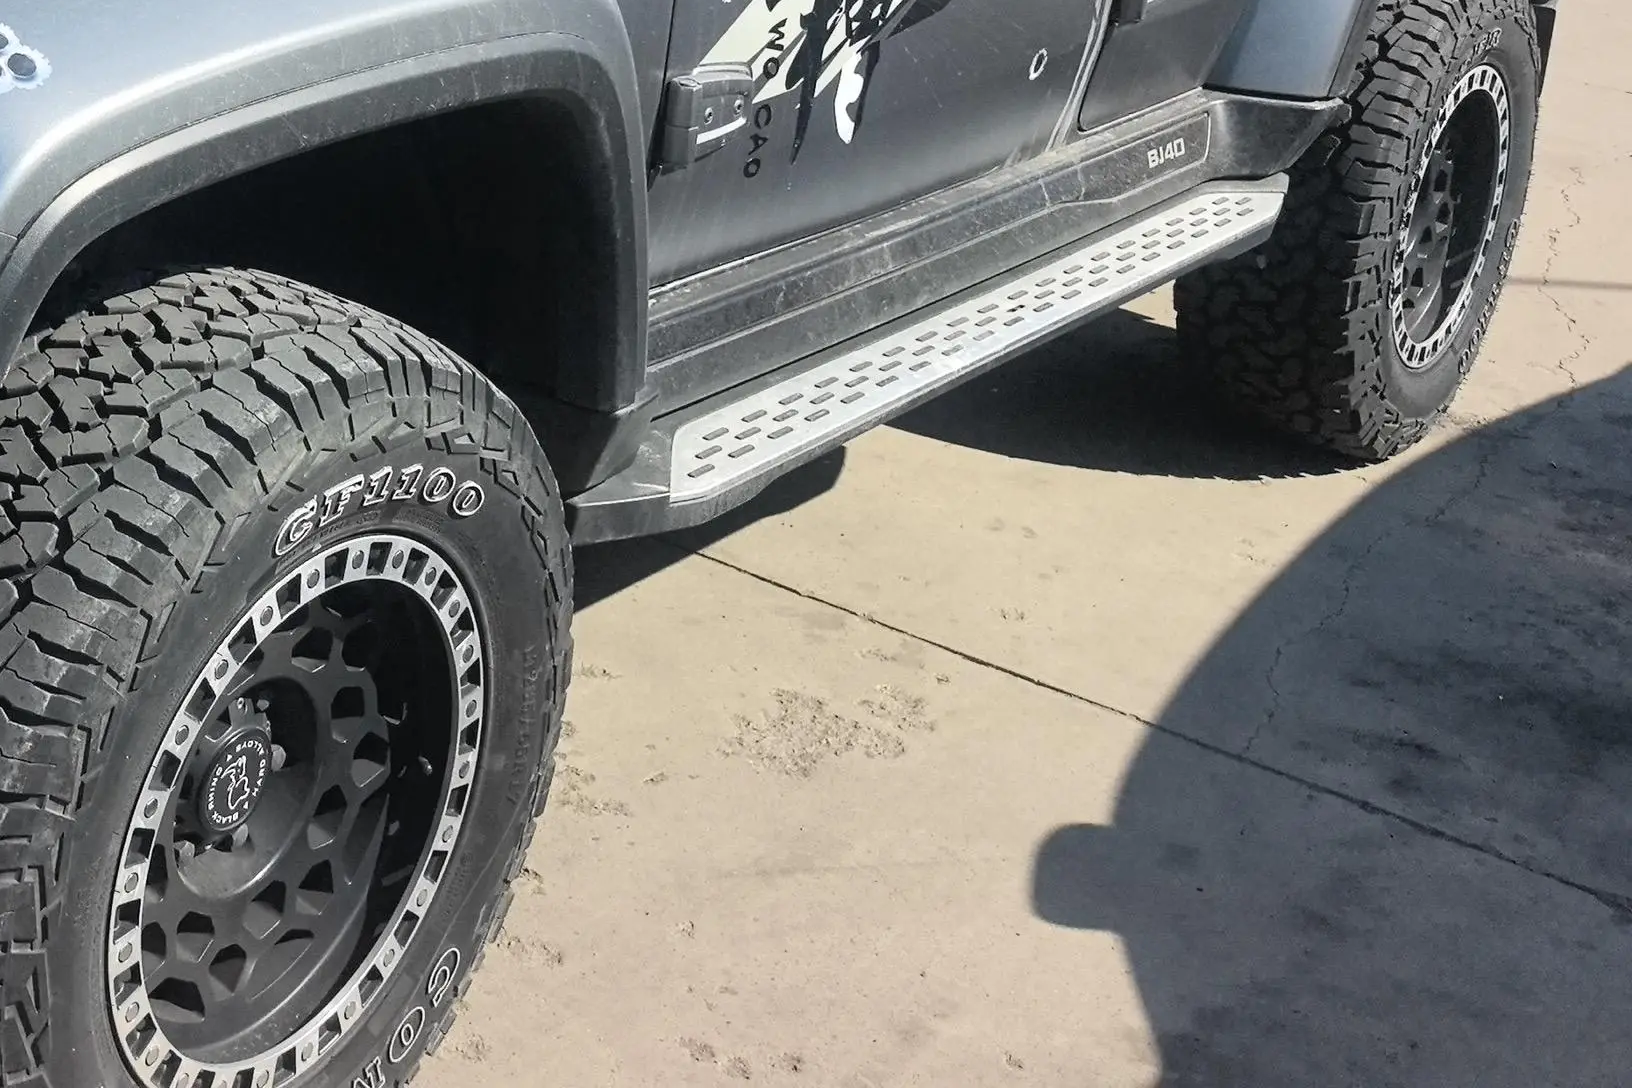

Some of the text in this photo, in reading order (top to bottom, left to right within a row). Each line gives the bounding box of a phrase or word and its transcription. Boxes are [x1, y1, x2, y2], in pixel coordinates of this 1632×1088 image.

[1147, 137, 1186, 169] BJ40
[207, 765, 239, 825] BLACK RHINO
